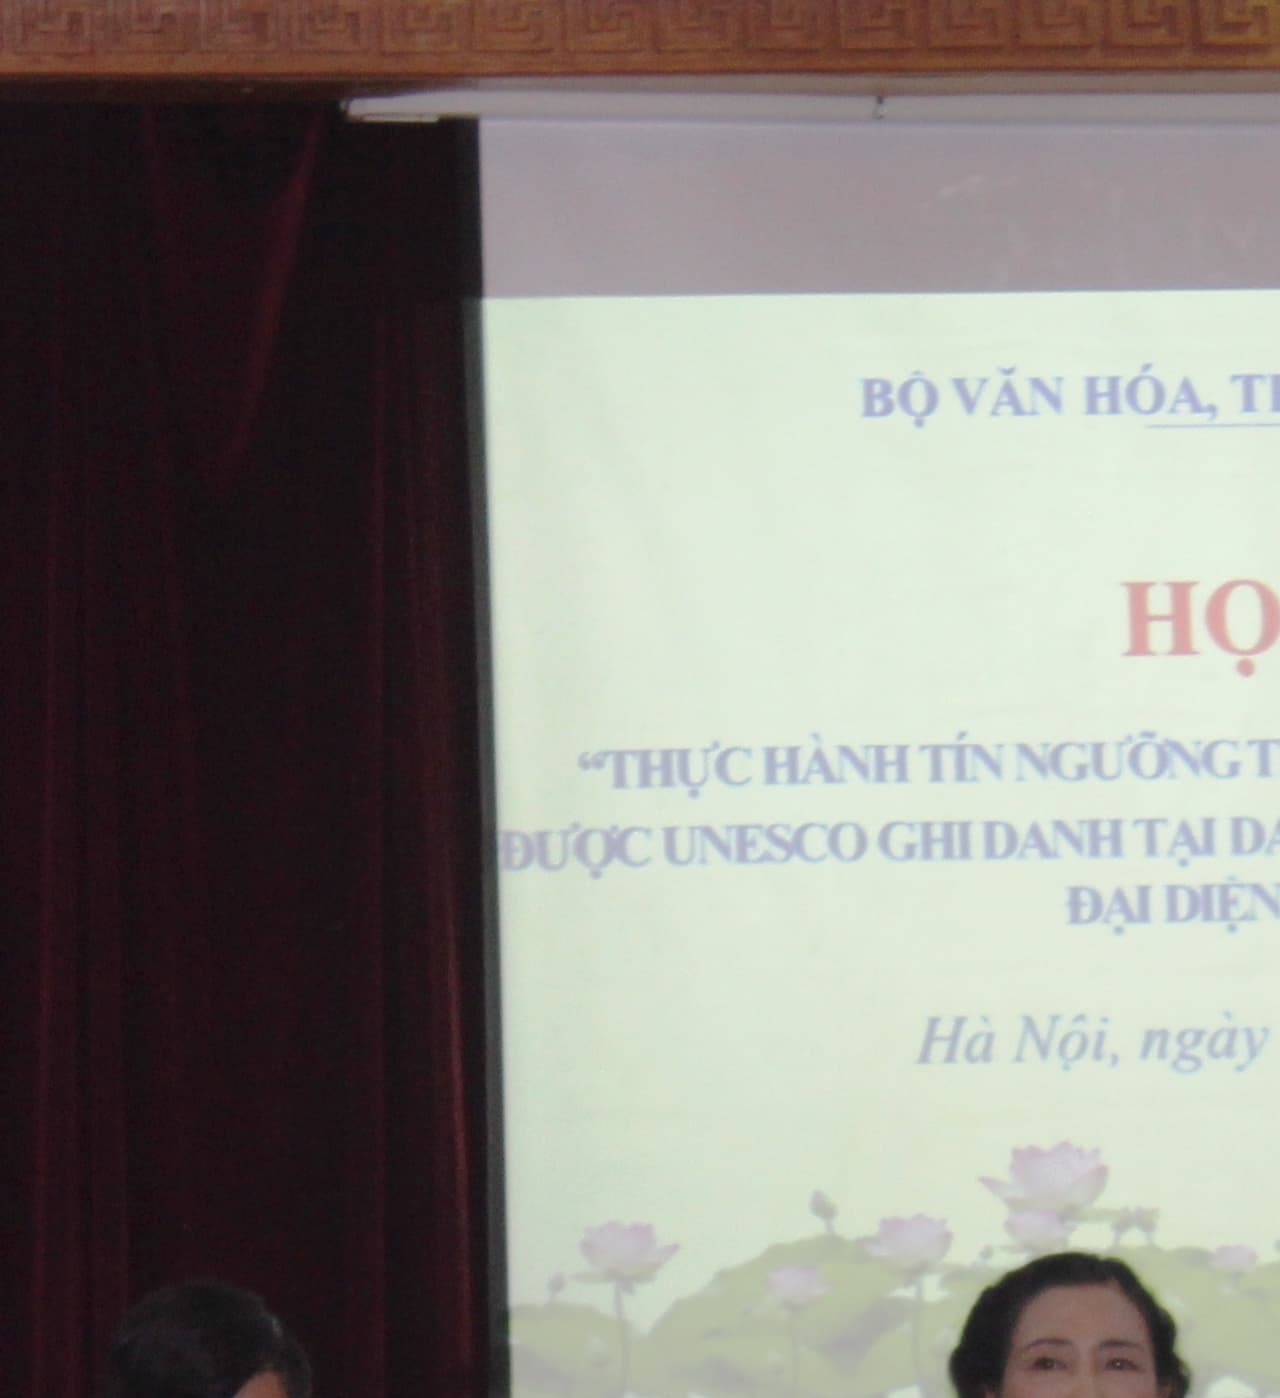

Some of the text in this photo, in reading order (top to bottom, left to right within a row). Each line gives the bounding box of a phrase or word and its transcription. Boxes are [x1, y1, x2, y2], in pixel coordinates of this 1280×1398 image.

[860, 370, 940, 428] BỘ
[950, 366, 1065, 417] VĂN
[1083, 363, 1219, 421] HÓA,
[763, 732, 910, 785] HÀNH
[920, 731, 1008, 783] TÍN
[1015, 729, 1242, 782] NGƯỠNG
[498, 822, 652, 880] ĐƯỢC
[663, 823, 868, 866] UNESCO
[877, 820, 974, 862] GHI
[982, 818, 1124, 861] DANH
[1133, 816, 1216, 868] TẠI
[1066, 885, 1153, 936] ĐẠI
[914, 1015, 996, 1066] Hà
[1012, 1013, 1123, 1070] Nội,
[1138, 1009, 1272, 1076] ngày
